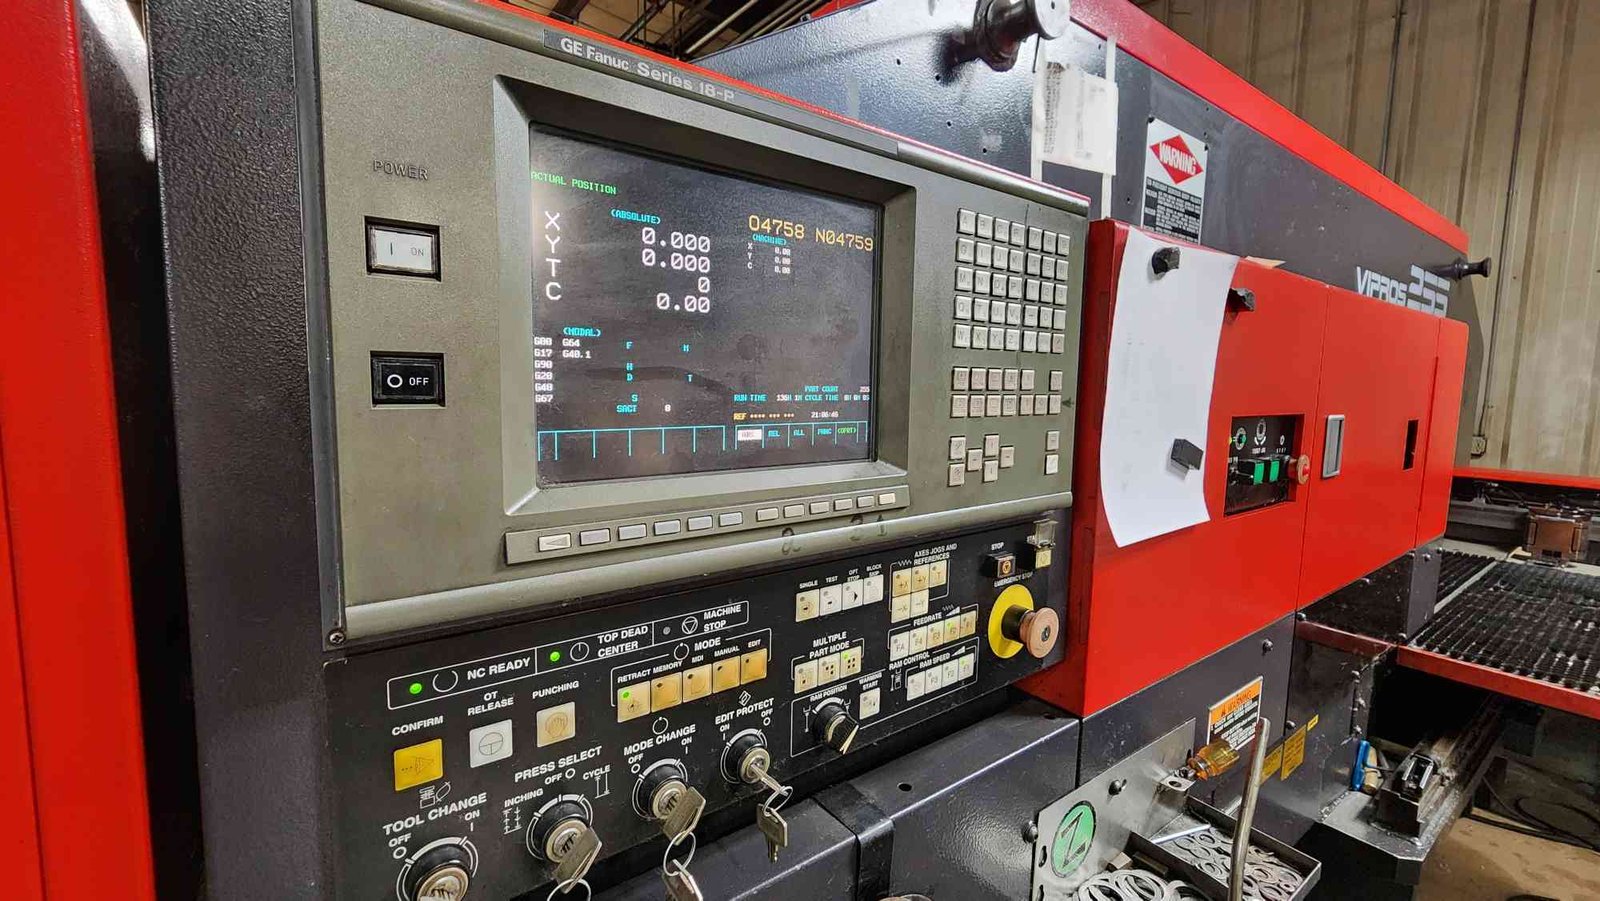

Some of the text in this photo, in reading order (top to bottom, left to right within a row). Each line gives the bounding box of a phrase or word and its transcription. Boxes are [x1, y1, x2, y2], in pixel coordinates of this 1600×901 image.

[560, 37, 583, 56] GE
[586, 45, 629, 71] Fanuc
[637, 62, 693, 91] Series
[1159, 141, 1196, 176] WARNING
[373, 159, 429, 180] POWER
[531, 171, 617, 195] ACTUAL POSITION
[611, 208, 661, 225] (ABSOLUTE)
[545, 211, 710, 252] X 0.000
[815, 227, 874, 252] N04759
[411, 246, 424, 257] ON
[545, 234, 710, 273] Y 0.000
[546, 258, 710, 293] T 0
[546, 282, 711, 313] C 0.00
[563, 326, 601, 337] (MODAL)
[626, 341, 633, 350] F
[409, 377, 429, 387] OFF
[626, 373, 693, 382] D T
[631, 394, 638, 402] S
[750, 394, 767, 402] TIME
[616, 405, 638, 413] SACT
[914, 543, 958, 558] AXES JOGS AND
[991, 541, 1004, 550] STOP
[914, 552, 950, 565] REFERENCES
[800, 580, 818, 589] SINGLE
[704, 604, 741, 619] MACHINE
[914, 612, 942, 626] FEEDRATE
[704, 619, 726, 632] STOP
[598, 626, 648, 645] TOP DEAD
[813, 631, 847, 648] MULTIPLE
[598, 640, 638, 658] CENTER
[695, 637, 721, 651] MODE
[714, 645, 740, 657] MANUAL
[748, 639, 761, 648] EDIT
[809, 640, 849, 659] PART MODE
[691, 654, 704, 664] MDI
[889, 651, 930, 670] RAM CONTROL
[919, 652, 950, 669] RAM SPEED
[467, 657, 531, 680] NC READY
[653, 660, 683, 674] MEMORY
[617, 669, 650, 683] RETRACT
[532, 680, 580, 699] PUNCHING
[863, 680, 878, 690] START
[483, 691, 498, 701] OT
[810, 684, 848, 702] RAM POSITION
[467, 697, 514, 716] RELEASE
[715, 698, 774, 725] EDIT PROTECT
[760, 708, 774, 718] OFF
[391, 715, 444, 736] CONFIRM
[719, 724, 730, 733] ON
[623, 724, 696, 756] MODE CHANGE
[681, 736, 692, 746] ON
[514, 746, 602, 782] PRESS SELECT
[628, 753, 644, 764] OFF
[544, 773, 562, 785] OFF
[583, 764, 611, 780] CYCLE
[504, 788, 544, 807] INCHING
[382, 792, 487, 836] TOOL CHANGE
[464, 809, 481, 821] ON
[388, 833, 412, 848] OFF
